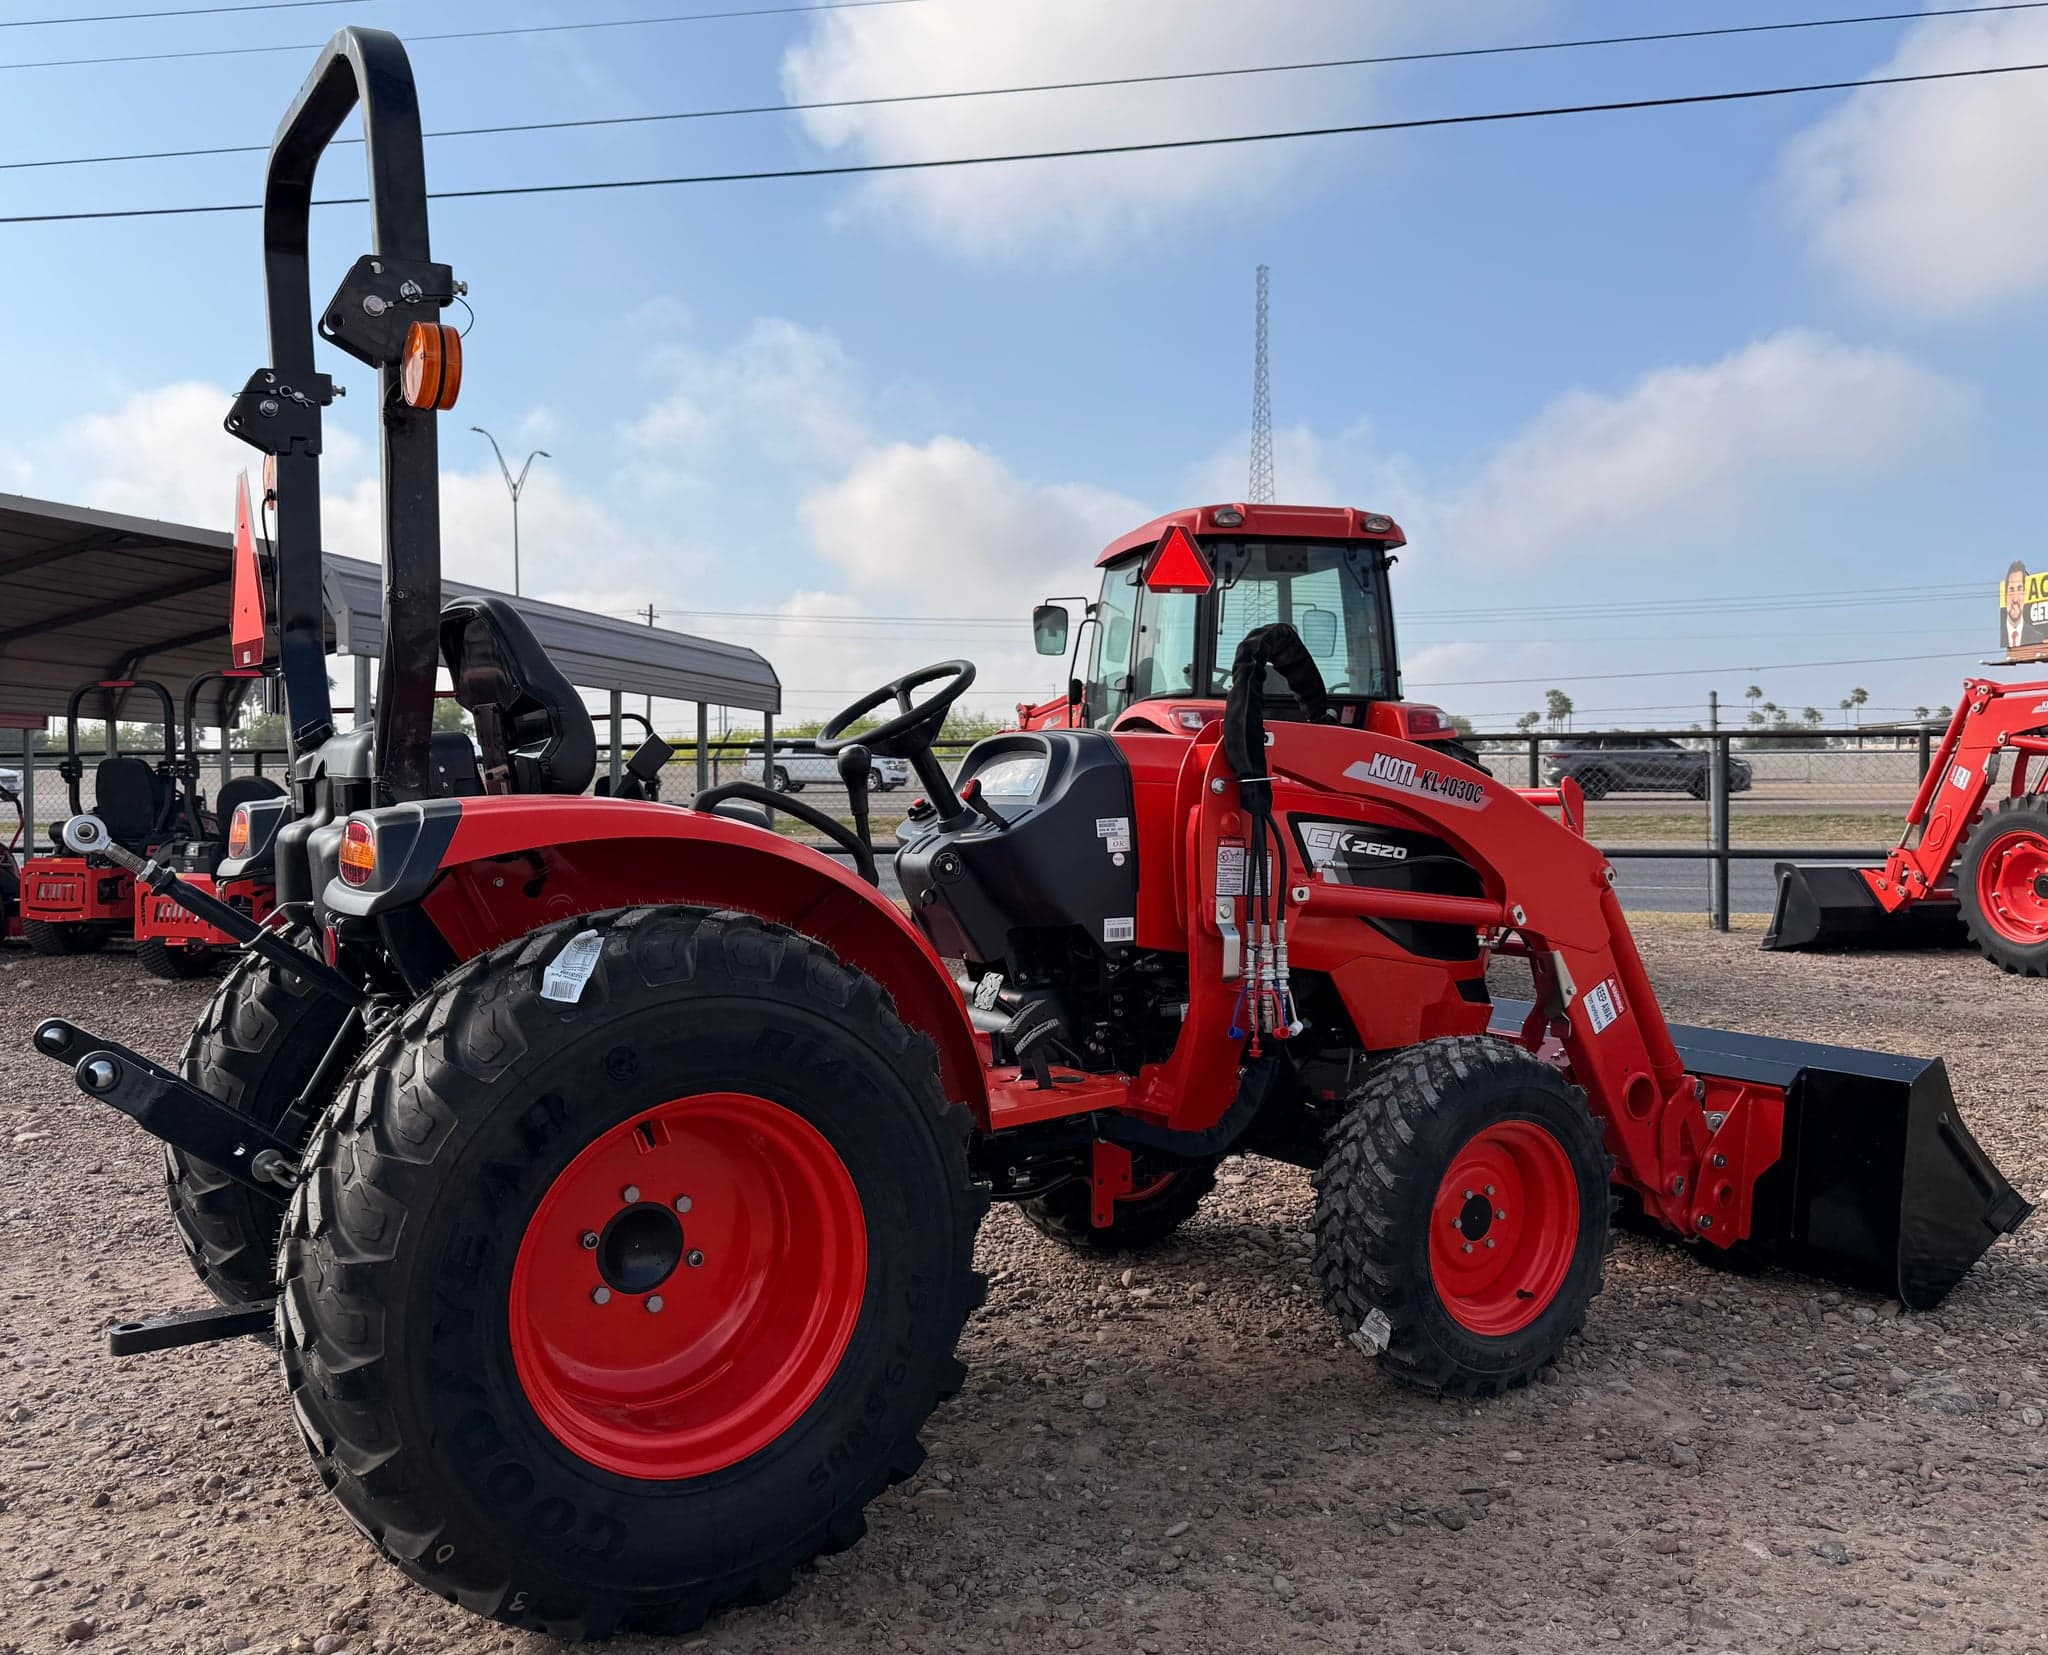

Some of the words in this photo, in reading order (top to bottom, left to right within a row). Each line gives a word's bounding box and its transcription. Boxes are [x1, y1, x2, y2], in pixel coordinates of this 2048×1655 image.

[1368, 752, 1417, 788] KIOTI
[1420, 768, 1485, 804] KL4030C
[38, 882, 78, 902] KIOTI
[1597, 985, 1607, 1002] KEEP
[1600, 1002, 1614, 1023] AWAY
